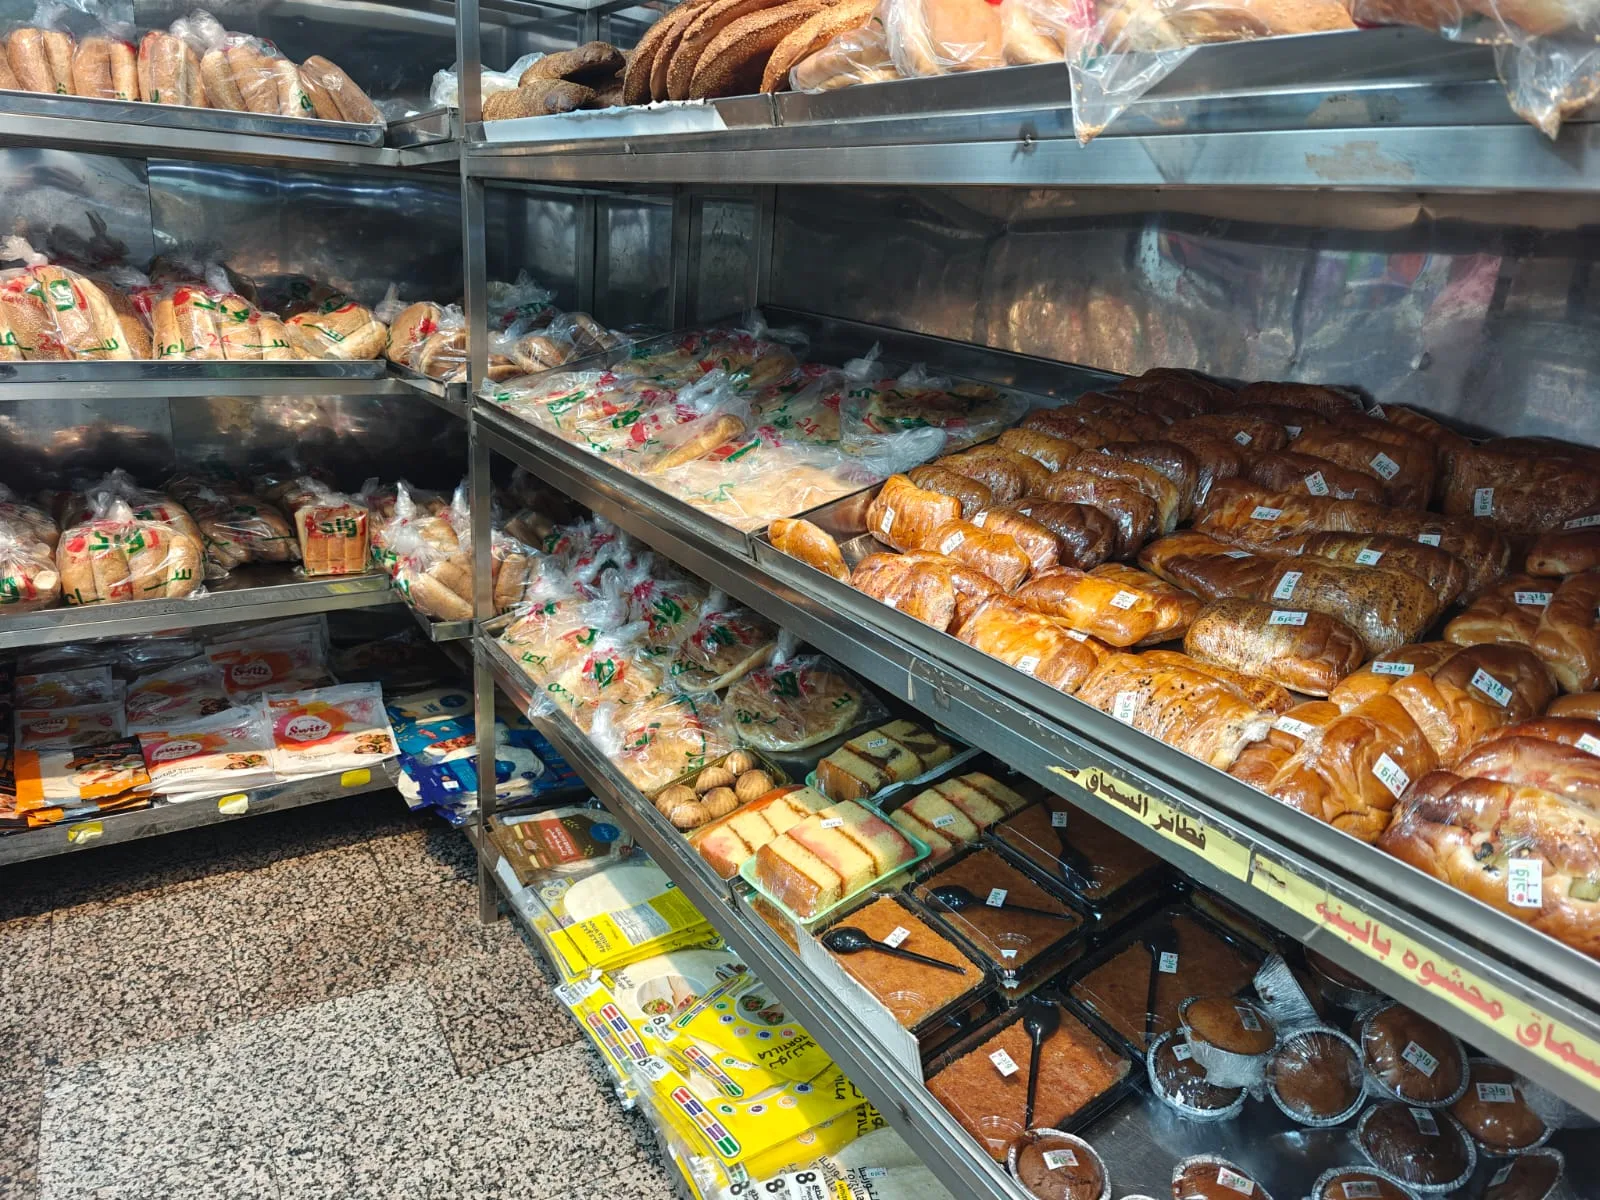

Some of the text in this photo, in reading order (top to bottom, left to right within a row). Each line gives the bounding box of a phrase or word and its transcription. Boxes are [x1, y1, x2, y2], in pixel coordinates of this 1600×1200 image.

[233, 666, 269, 677] Switz
[288, 723, 329, 736] Switz
[1085, 767, 1207, 850] فطائر السماق
[1402, 947, 1505, 1020] محشوه
[757, 1033, 809, 1060] TORTILLA
[765, 1178, 786, 1193] 8
[795, 1172, 816, 1184] 8
